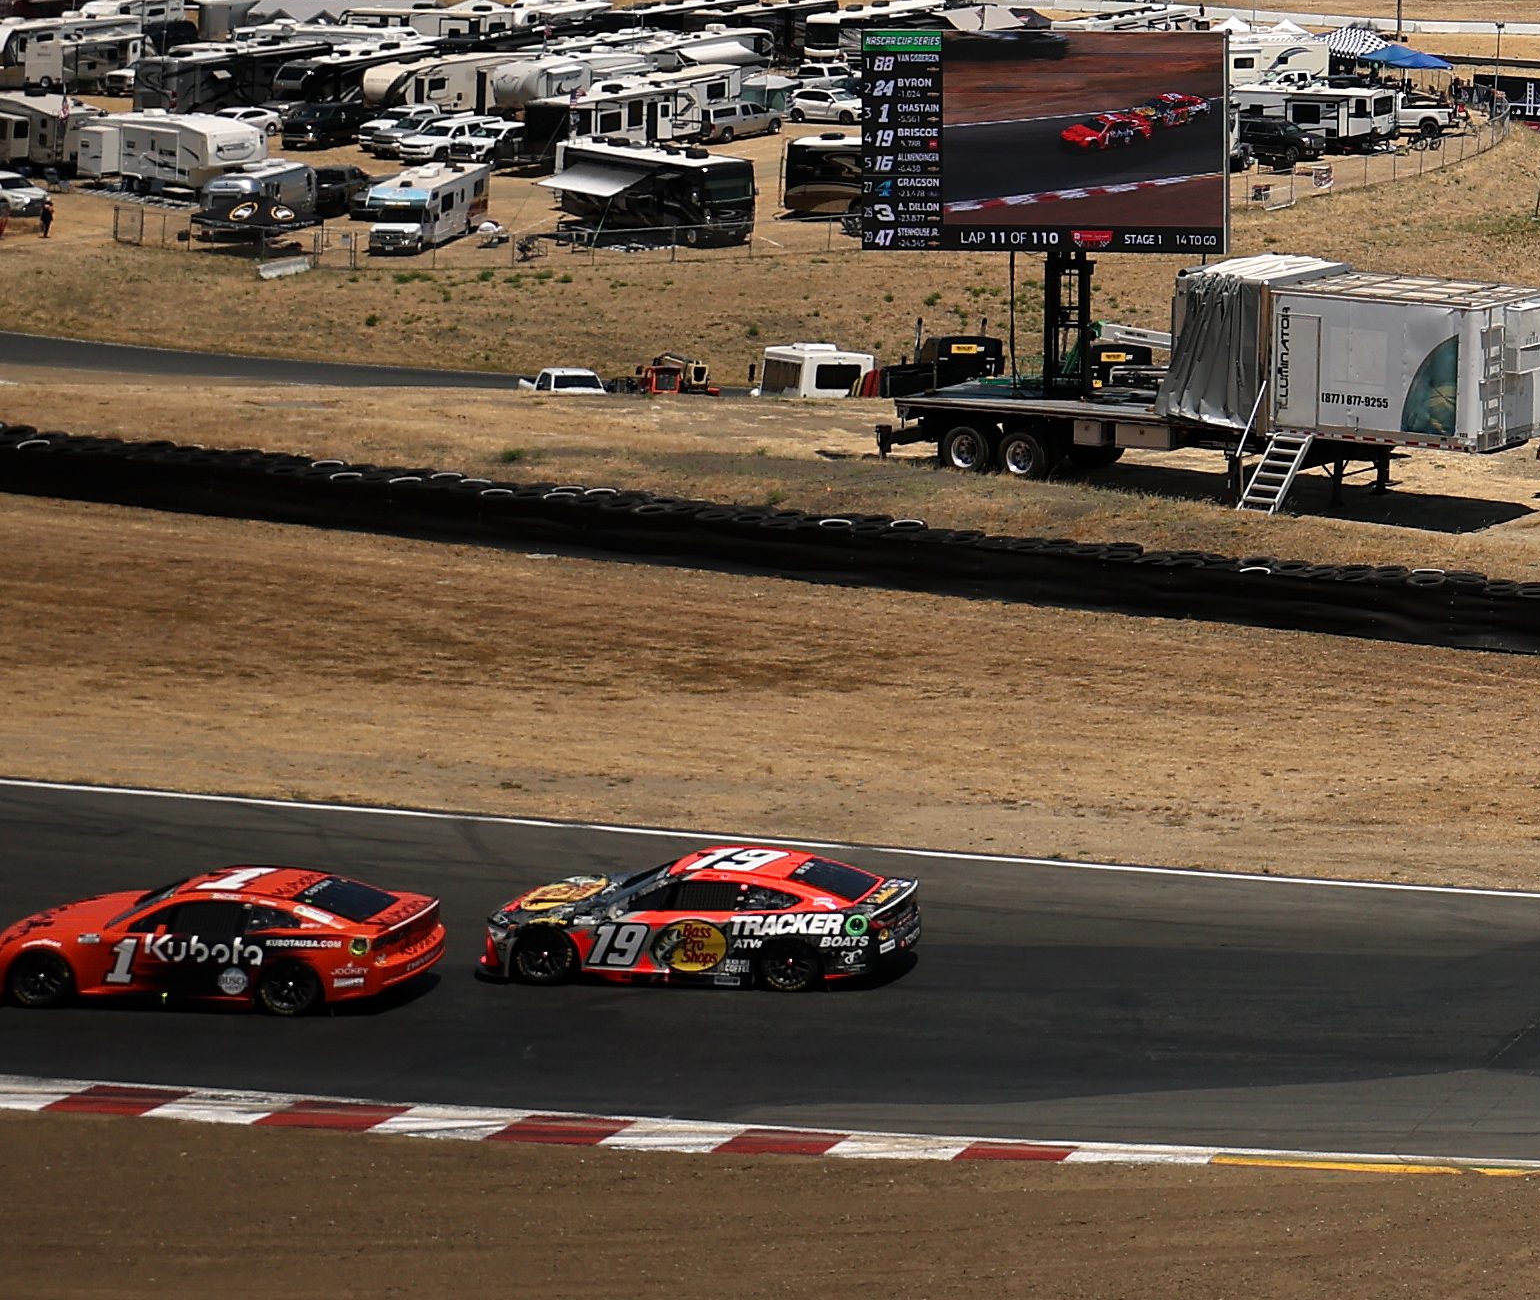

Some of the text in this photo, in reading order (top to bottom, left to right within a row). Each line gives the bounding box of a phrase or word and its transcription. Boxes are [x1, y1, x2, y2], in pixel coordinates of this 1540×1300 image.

[866, 36, 941, 45] NASCAR CUP SERIES
[866, 56, 895, 71] 1 88
[864, 80, 895, 96] 2 24
[897, 78, 932, 87] BYRON
[864, 103, 889, 123] 3 1
[897, 103, 940, 112] CHASTAIN
[864, 129, 894, 147] 4 19
[897, 128, 939, 137] BRISCOE
[864, 155, 894, 171] 5 16
[863, 180, 892, 197] 27 4
[897, 178, 940, 187] GRAGSON
[874, 203, 896, 221] 3
[898, 203, 940, 211] A. DILLON
[863, 229, 895, 246] 29 47
[897, 228, 930, 237] STENHOUSE
[961, 231, 1059, 244] LAP 11 OF 110
[1124, 234, 1155, 245] STAGE
[1158, 235, 1162, 245] 1
[1176, 235, 1217, 246] 14 TO GO
[1321, 392, 1389, 409] (877) 877-9255
[686, 848, 789, 871] 19
[195, 867, 279, 890] 1
[682, 922, 712, 939] Bass
[730, 913, 845, 936] TRACKER
[144, 932, 264, 967] Kubota
[265, 938, 342, 949] KUBOTAUSA.COM
[587, 923, 649, 967] 19
[682, 939, 704, 951] Pro
[819, 936, 870, 948] BOATS
[105, 937, 138, 984] 1
[681, 951, 718, 967] Shops
[331, 967, 369, 976] JOCKEY
